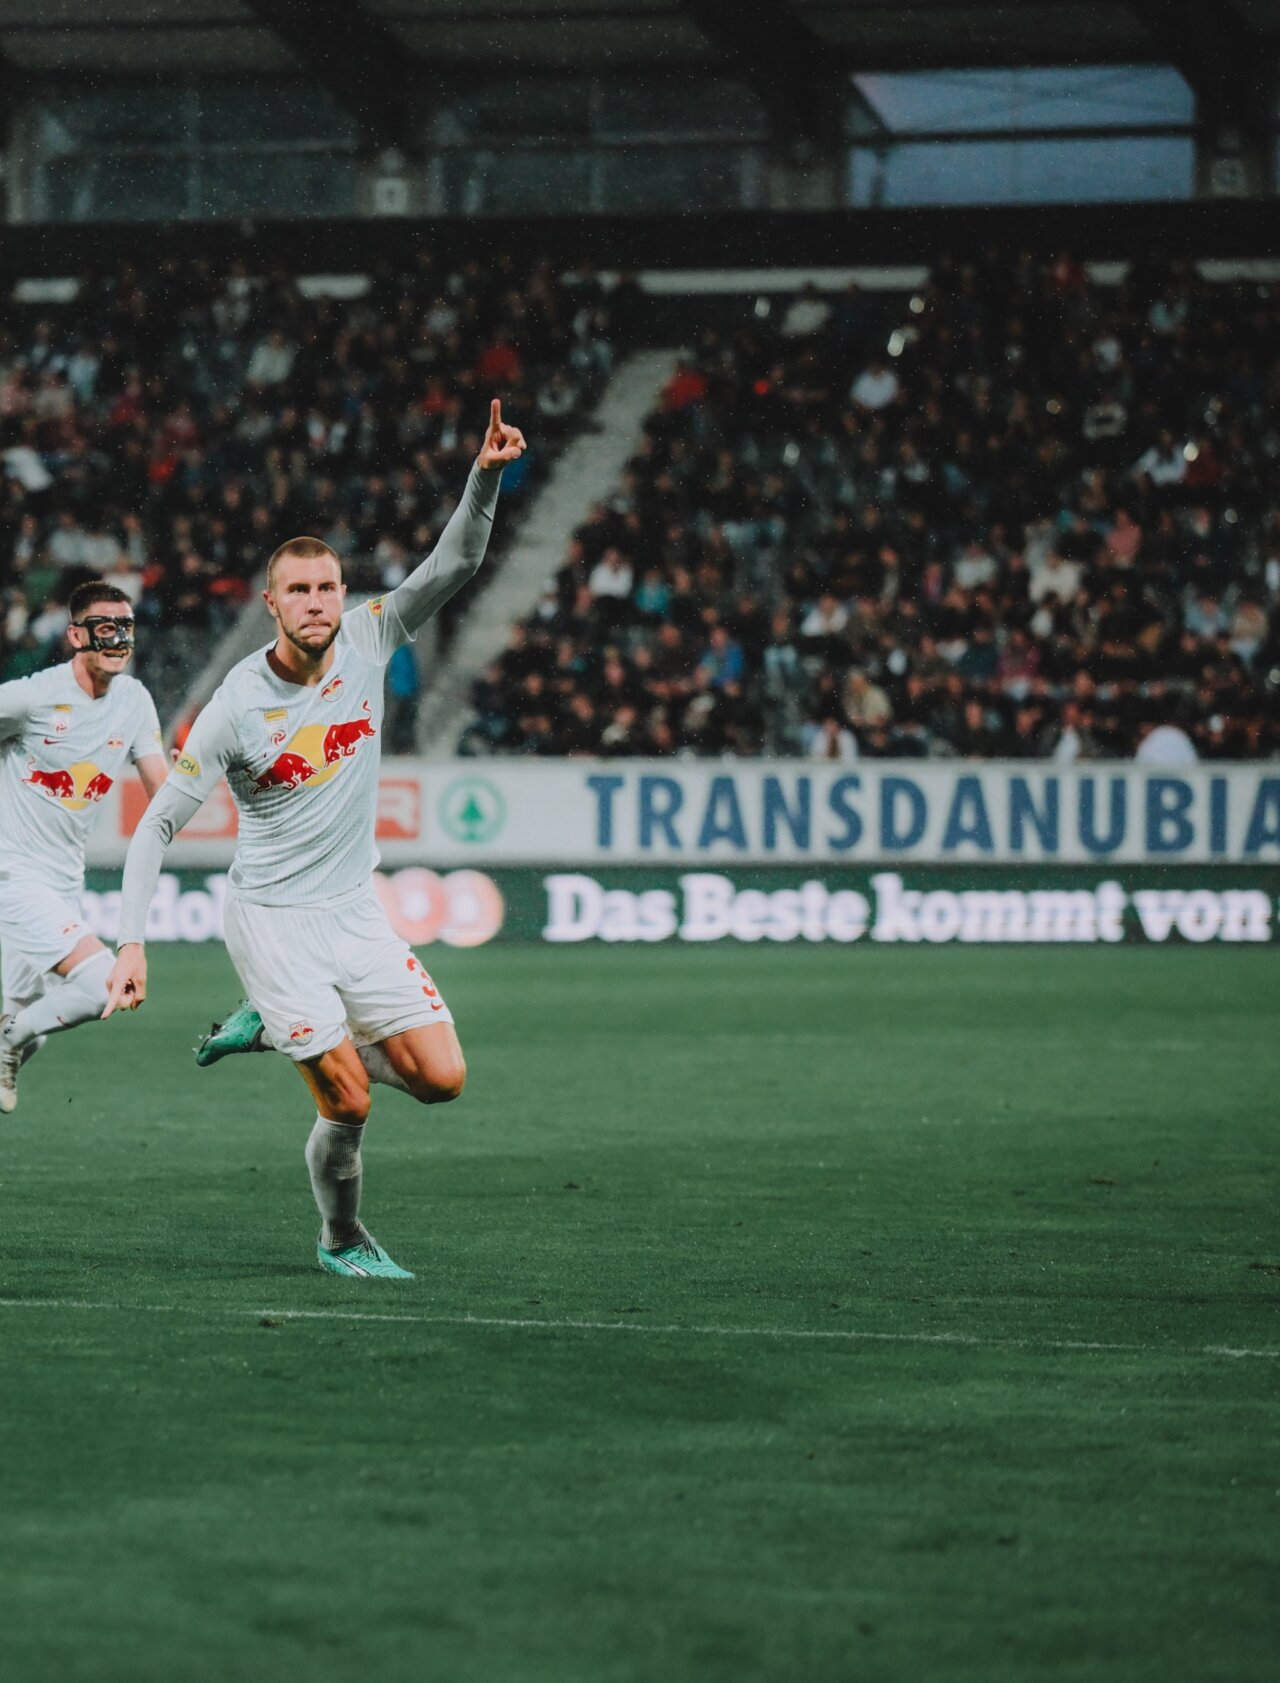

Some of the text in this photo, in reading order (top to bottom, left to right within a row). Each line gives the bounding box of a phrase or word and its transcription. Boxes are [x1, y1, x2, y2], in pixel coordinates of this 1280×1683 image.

[587, 776, 1280, 852] TRANSDANUBIA
[542, 872, 1271, 943] Das Beste kommt von
